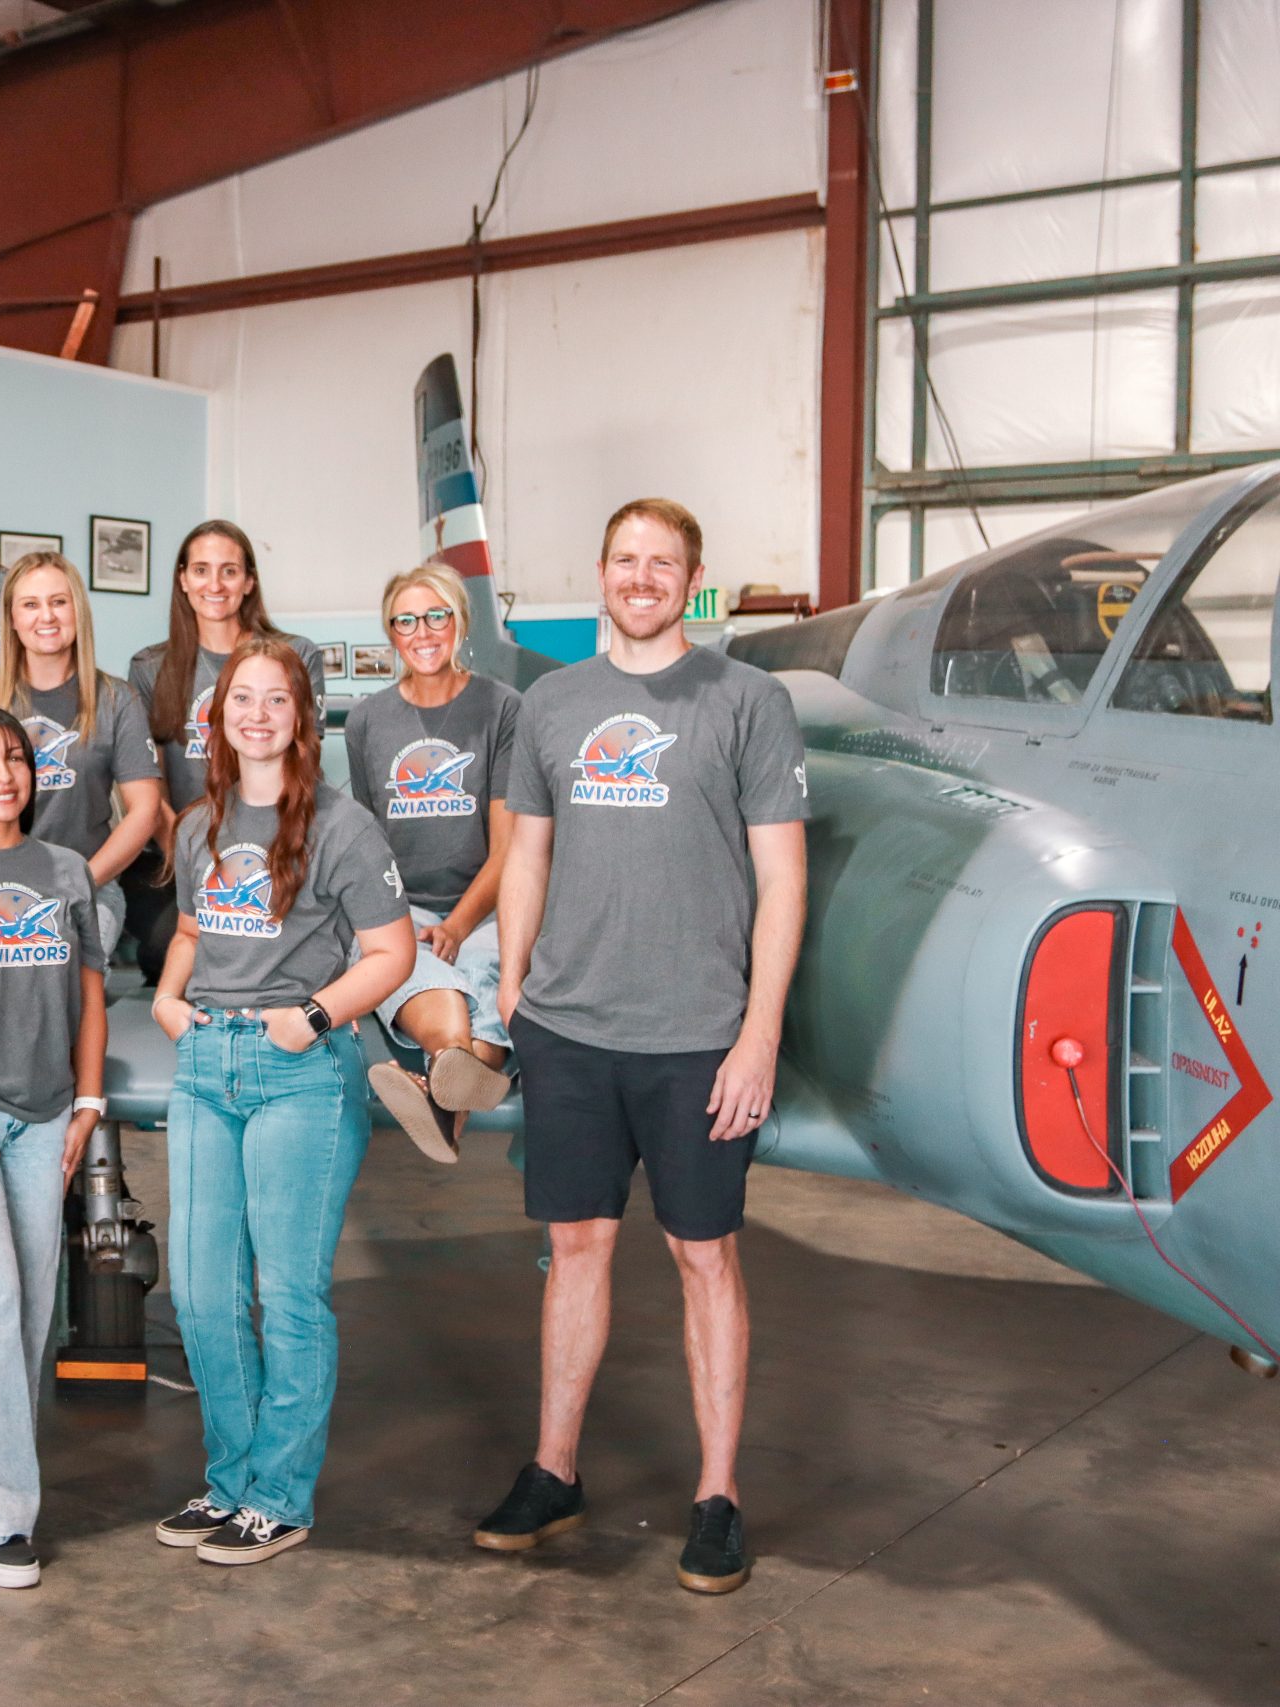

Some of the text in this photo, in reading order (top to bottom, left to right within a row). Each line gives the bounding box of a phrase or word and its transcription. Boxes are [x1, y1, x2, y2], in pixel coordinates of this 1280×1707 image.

[573, 785, 665, 802] AVIATORS
[390, 798, 473, 815] AVIATORS
[198, 913, 278, 935] AVIATORS
[1203, 988, 1232, 1043] ULAZ
[1172, 1051, 1230, 1091] OPASNOST
